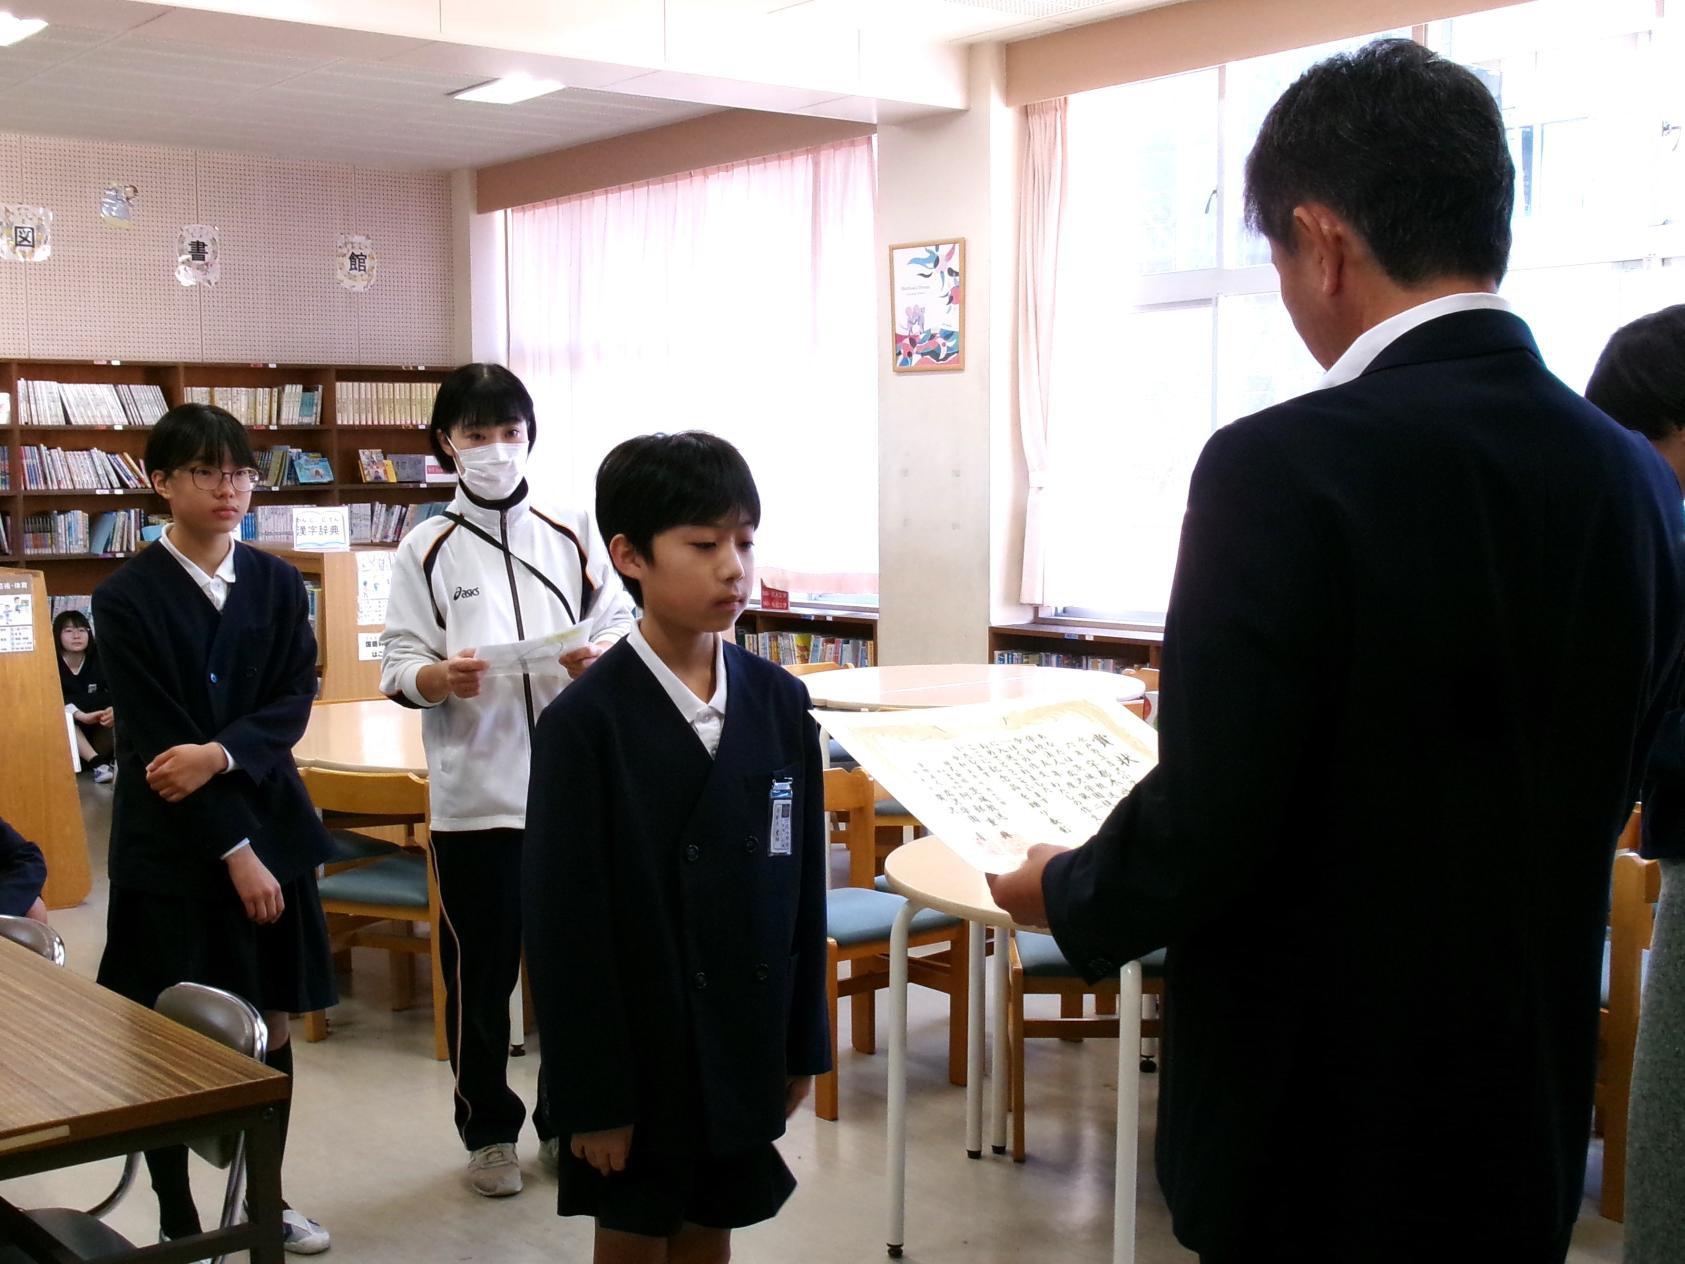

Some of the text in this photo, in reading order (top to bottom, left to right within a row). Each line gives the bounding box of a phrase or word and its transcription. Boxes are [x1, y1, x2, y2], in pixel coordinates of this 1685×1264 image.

[14, 226, 367, 273] 図 書 館
[296, 525, 340, 536] 漢字辞典
